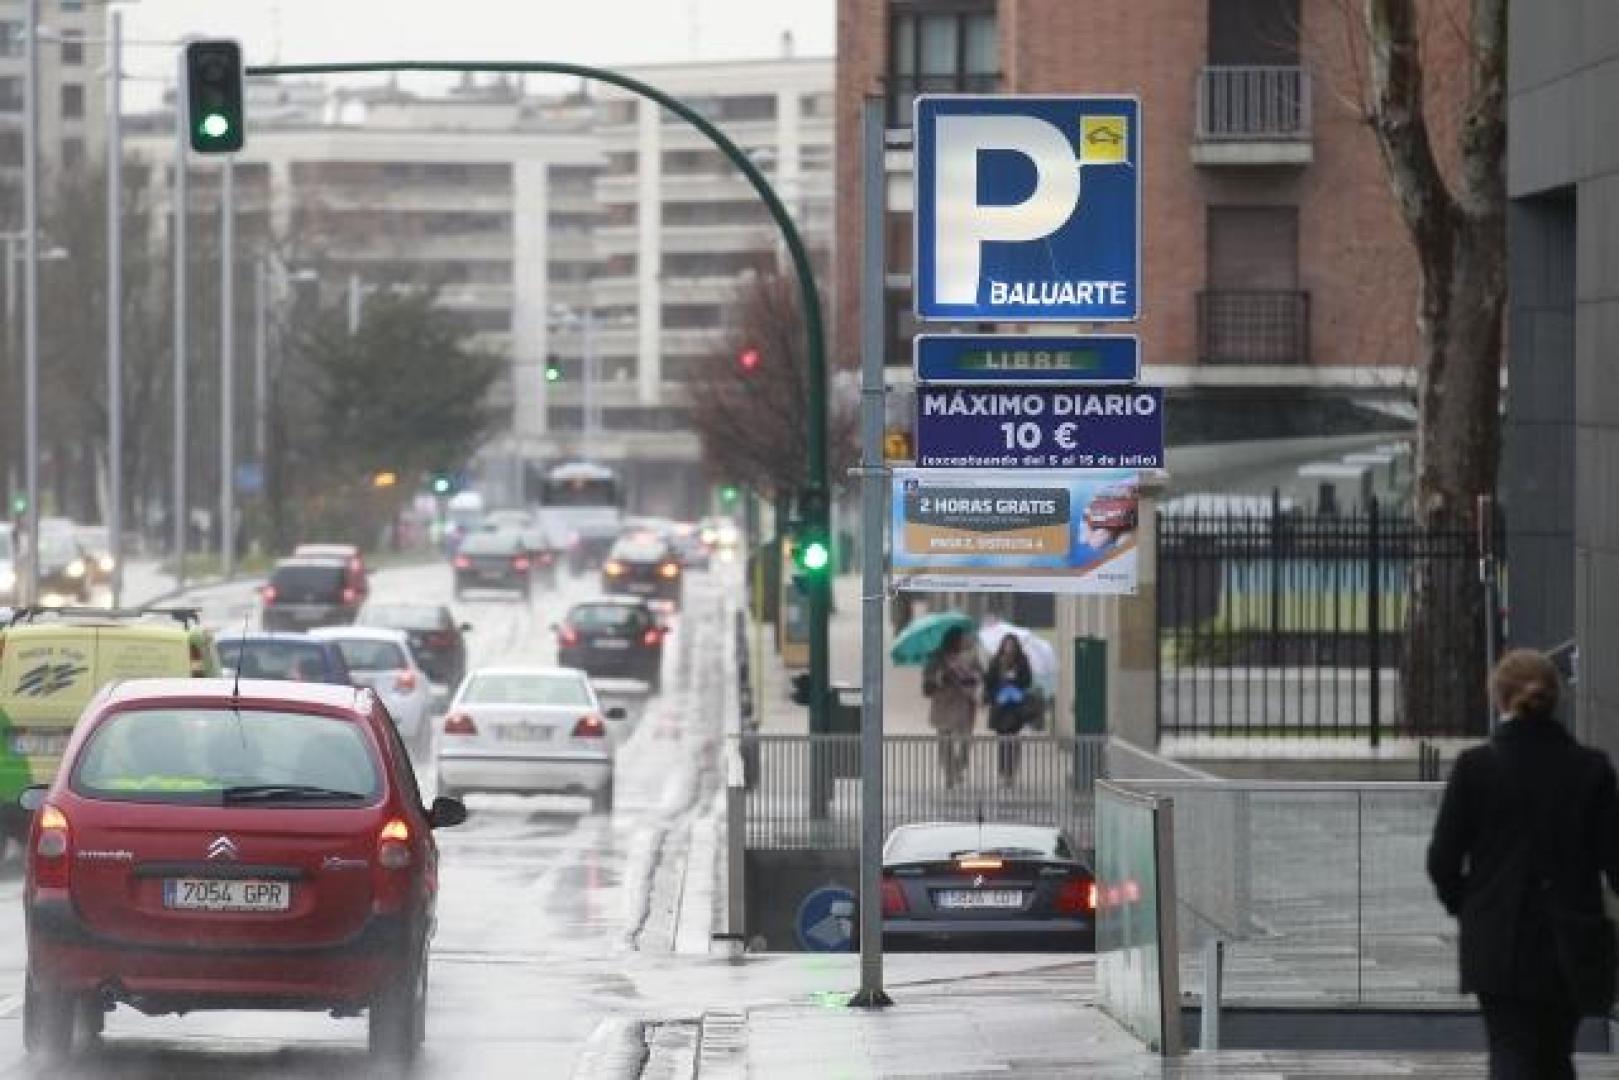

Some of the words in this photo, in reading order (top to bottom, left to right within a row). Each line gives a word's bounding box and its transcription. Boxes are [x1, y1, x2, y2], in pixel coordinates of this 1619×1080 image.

[935, 114, 1081, 304] P
[990, 281, 1127, 305] BALUARTE
[985, 351, 1072, 370] LIBRE
[924, 390, 1044, 415] MÁXIMO
[1053, 394, 1156, 415] DIARIO
[1000, 422, 1043, 449] 10
[1053, 422, 1079, 449] €
[1098, 454, 1116, 466] de
[919, 498, 931, 513] 2
[935, 498, 993, 514] HORAS
[996, 499, 1056, 514] GRATIS
[184, 881, 231, 902] 7054
[244, 884, 281, 904] GPR
